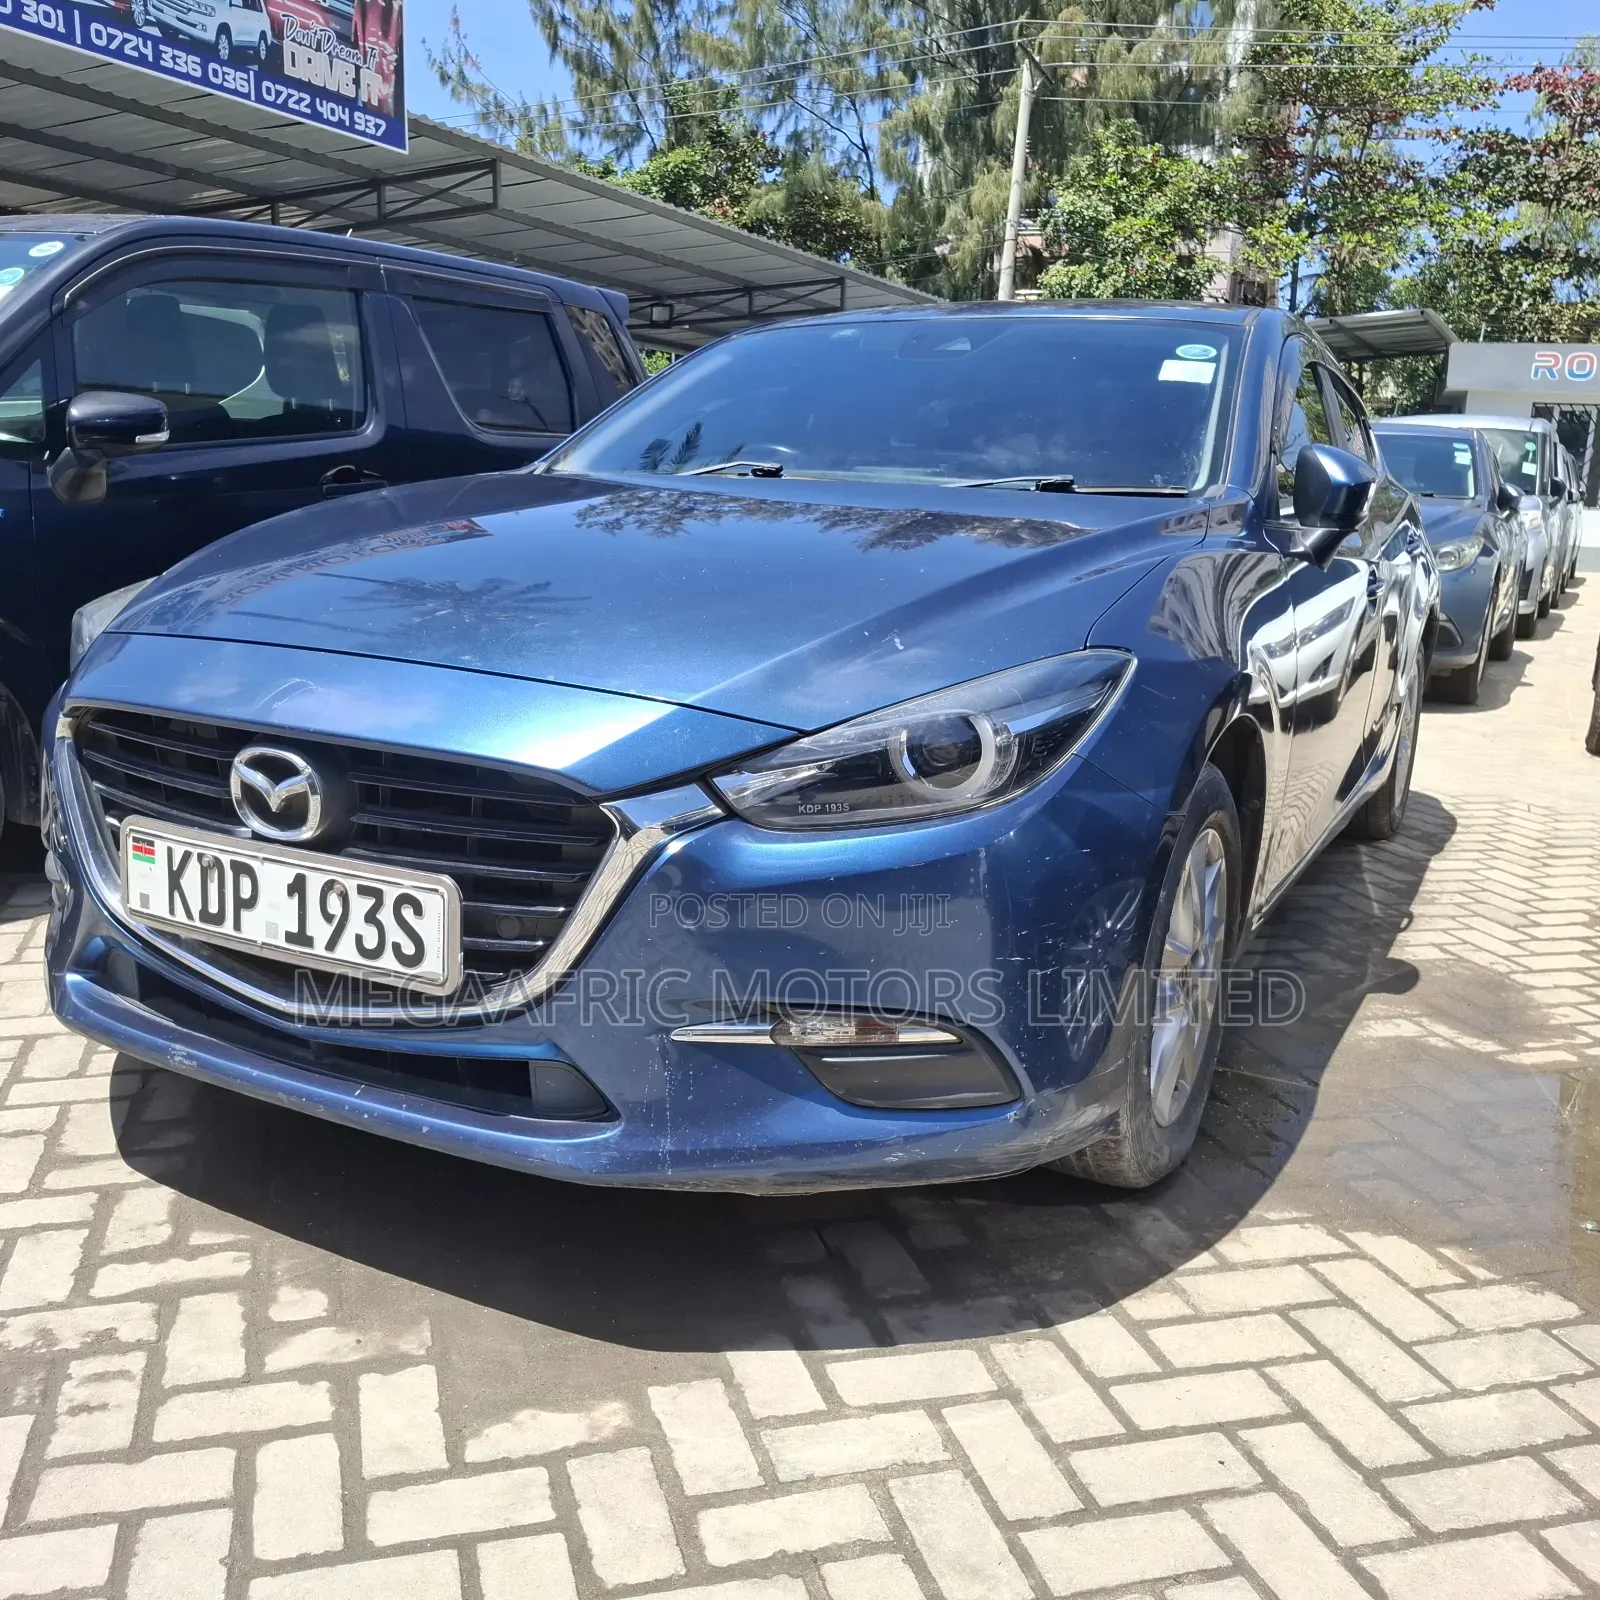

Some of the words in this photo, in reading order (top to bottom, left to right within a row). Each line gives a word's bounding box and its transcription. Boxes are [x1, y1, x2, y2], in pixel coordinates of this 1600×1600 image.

[21, 0, 66, 33] 301
[90, 22, 153, 62] 0724
[159, 44, 202, 78] 336
[261, 80, 311, 115] 0722
[315, 97, 350, 127] 404
[353, 111, 387, 137] 937
[283, 39, 356, 98] DRIVE
[360, 66, 383, 107] IT
[319, 26, 363, 67] Dream
[798, 804, 822, 814] KDP
[824, 802, 850, 813] 193S
[166, 845, 260, 934] KDP
[284, 872, 426, 970] 193S
